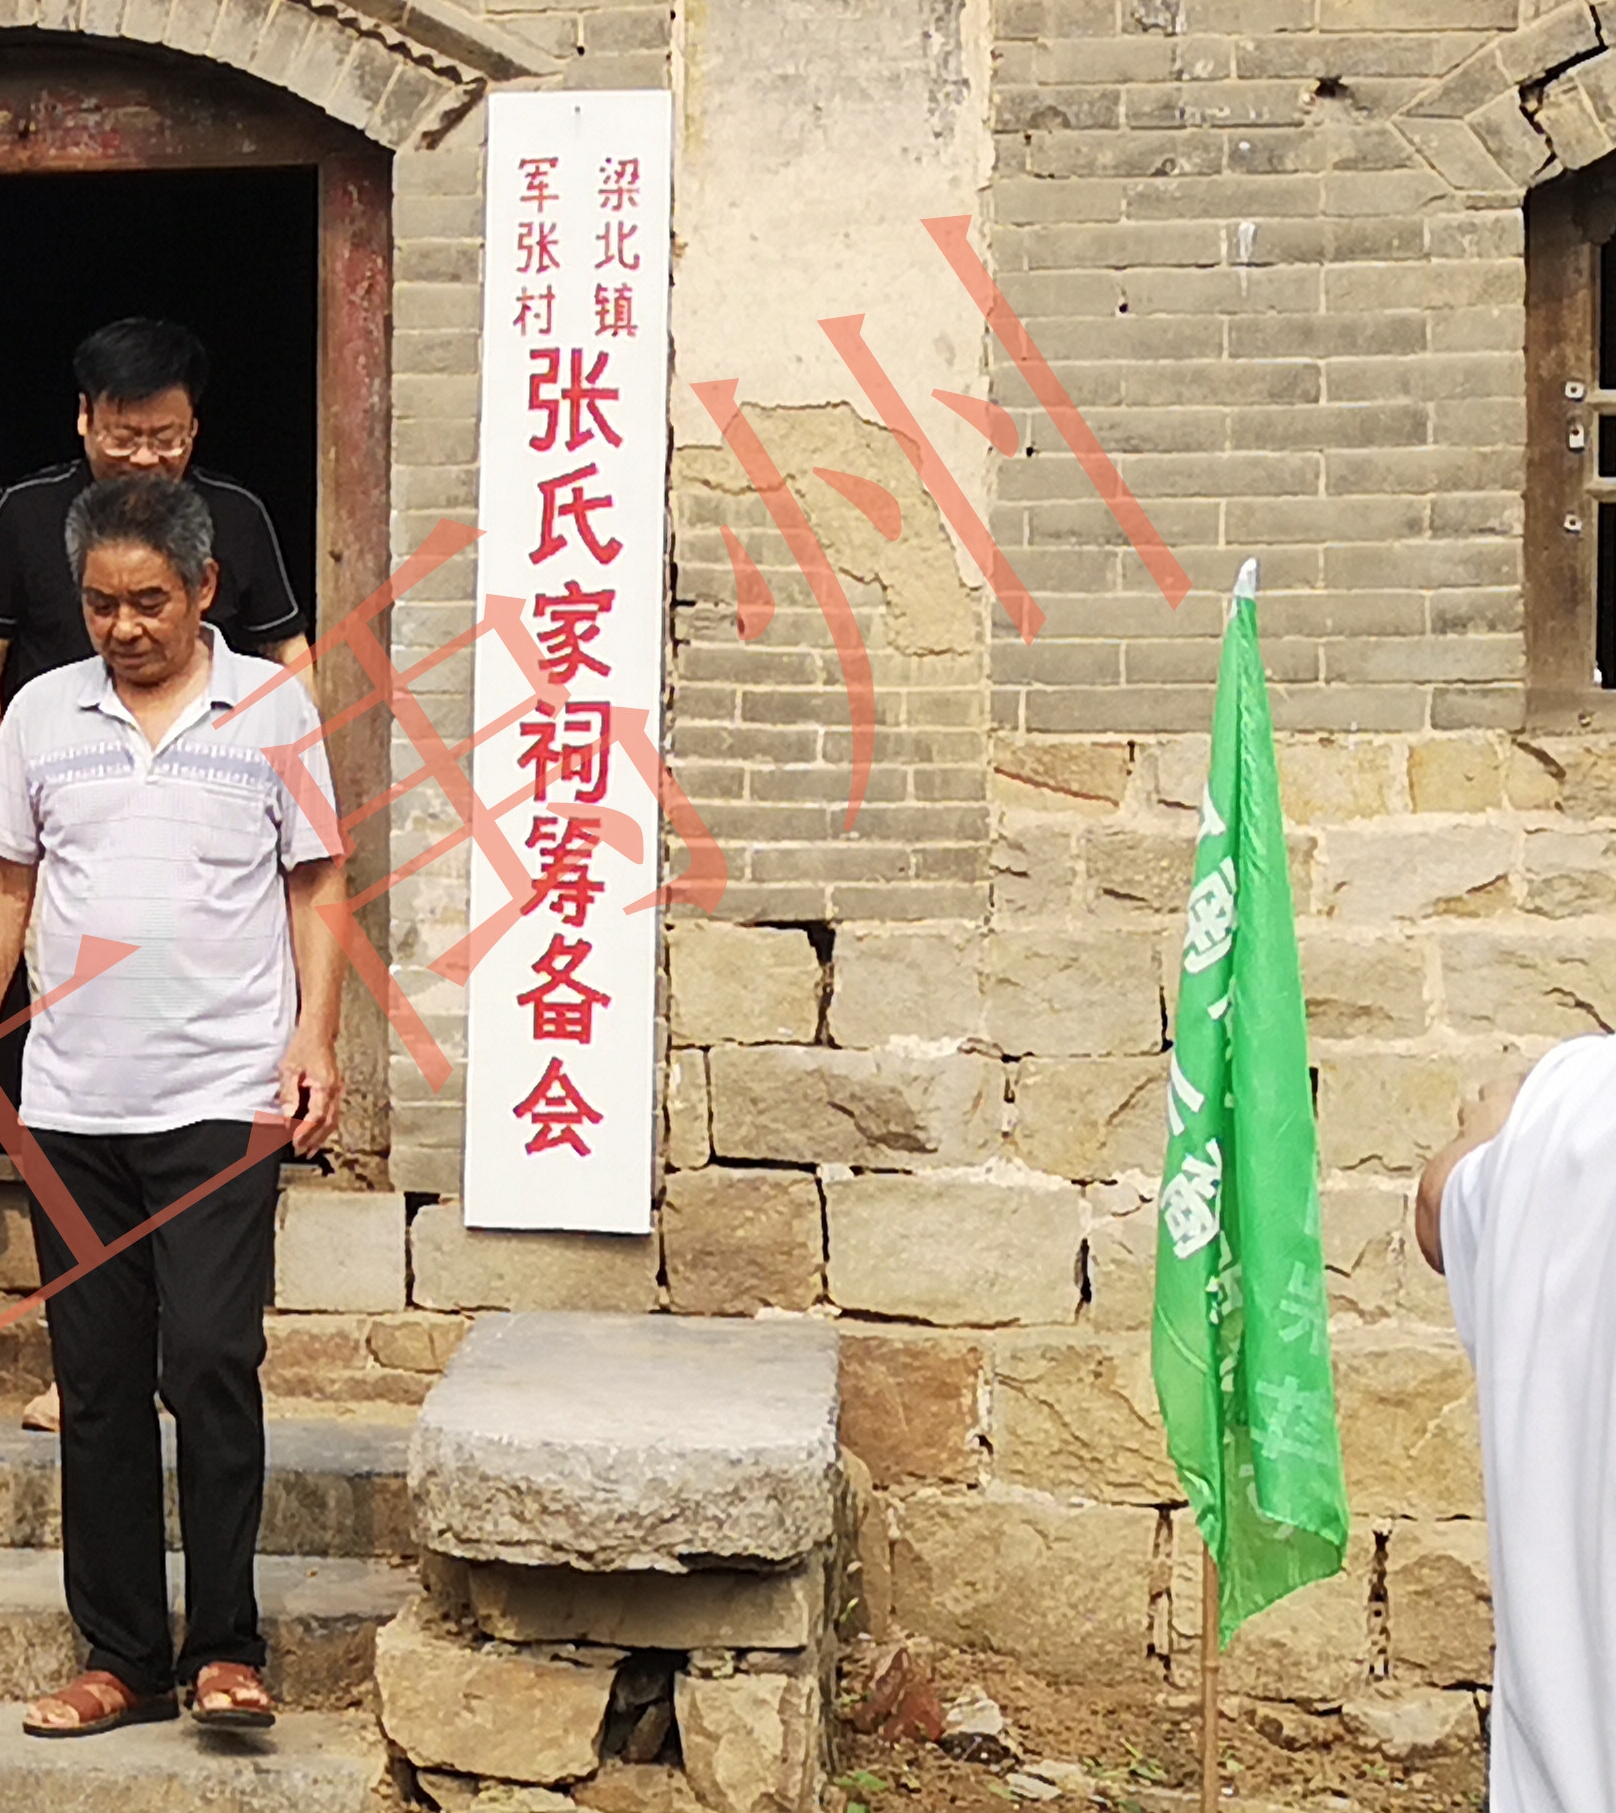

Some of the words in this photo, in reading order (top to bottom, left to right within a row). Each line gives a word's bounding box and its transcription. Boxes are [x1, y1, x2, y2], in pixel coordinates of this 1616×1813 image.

[512, 156, 561, 337] 军张村
[593, 156, 641, 338] 梁北镇
[512, 347, 625, 1159] 张氏家祠筹备会
